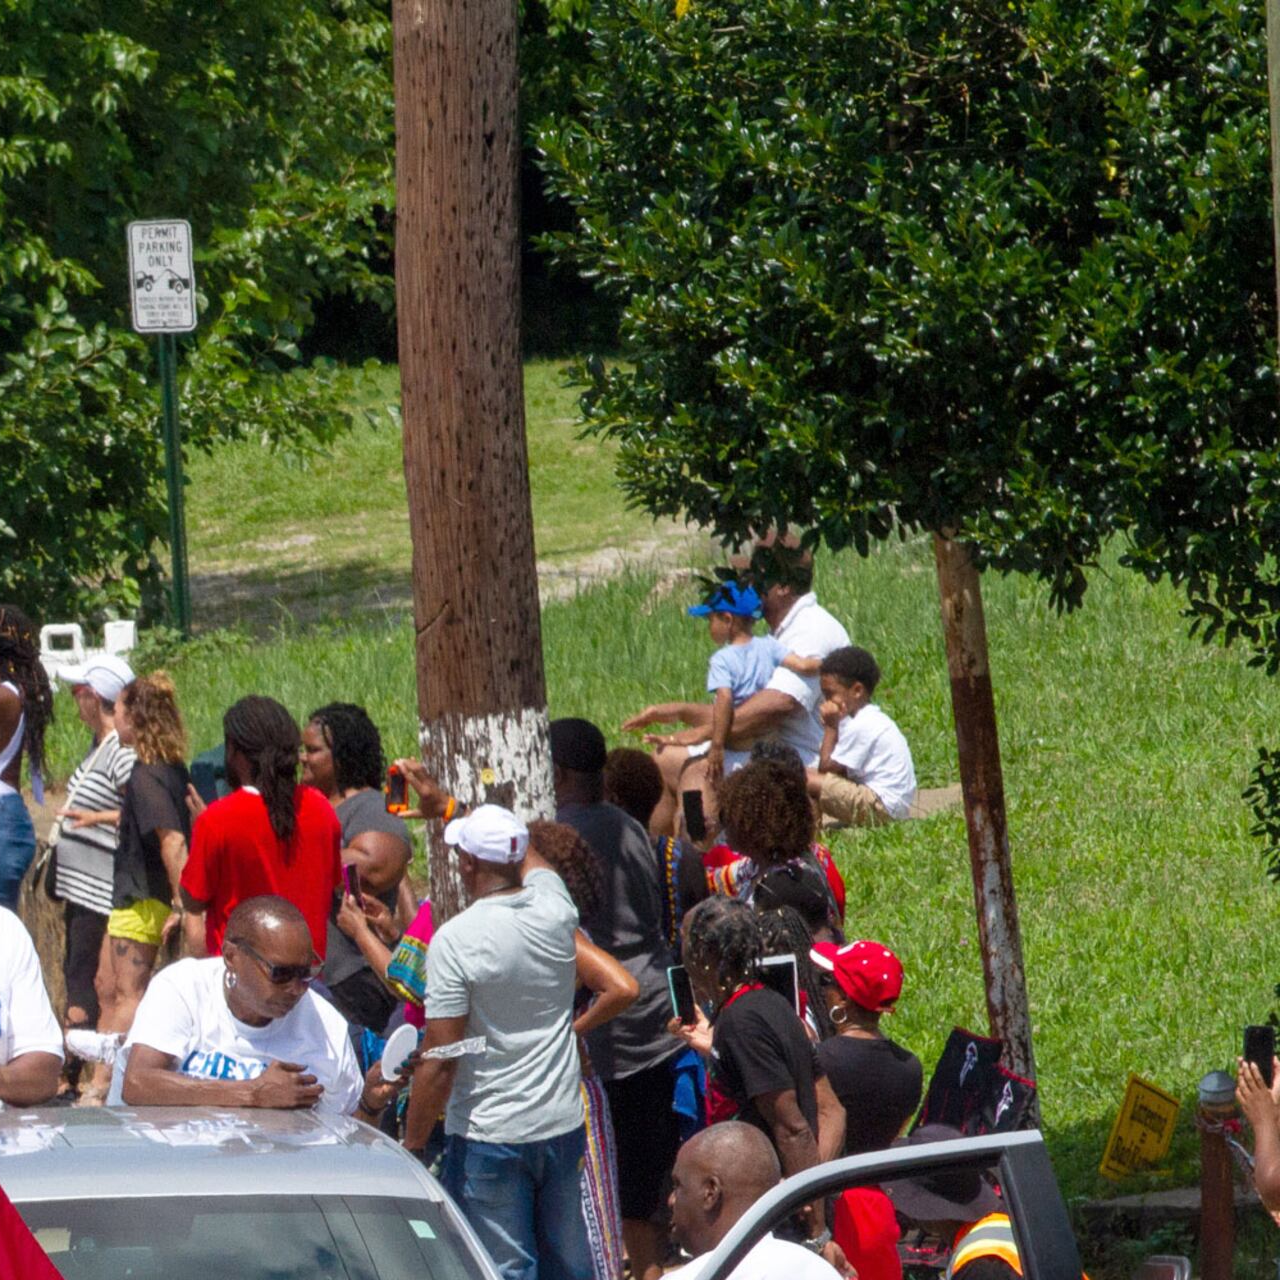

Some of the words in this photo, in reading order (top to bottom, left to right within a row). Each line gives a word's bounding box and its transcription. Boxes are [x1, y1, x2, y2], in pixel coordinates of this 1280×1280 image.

[141, 226, 178, 239] PERMIT
[138, 241, 183, 253] PARKING
[148, 255, 174, 267] ONLY
